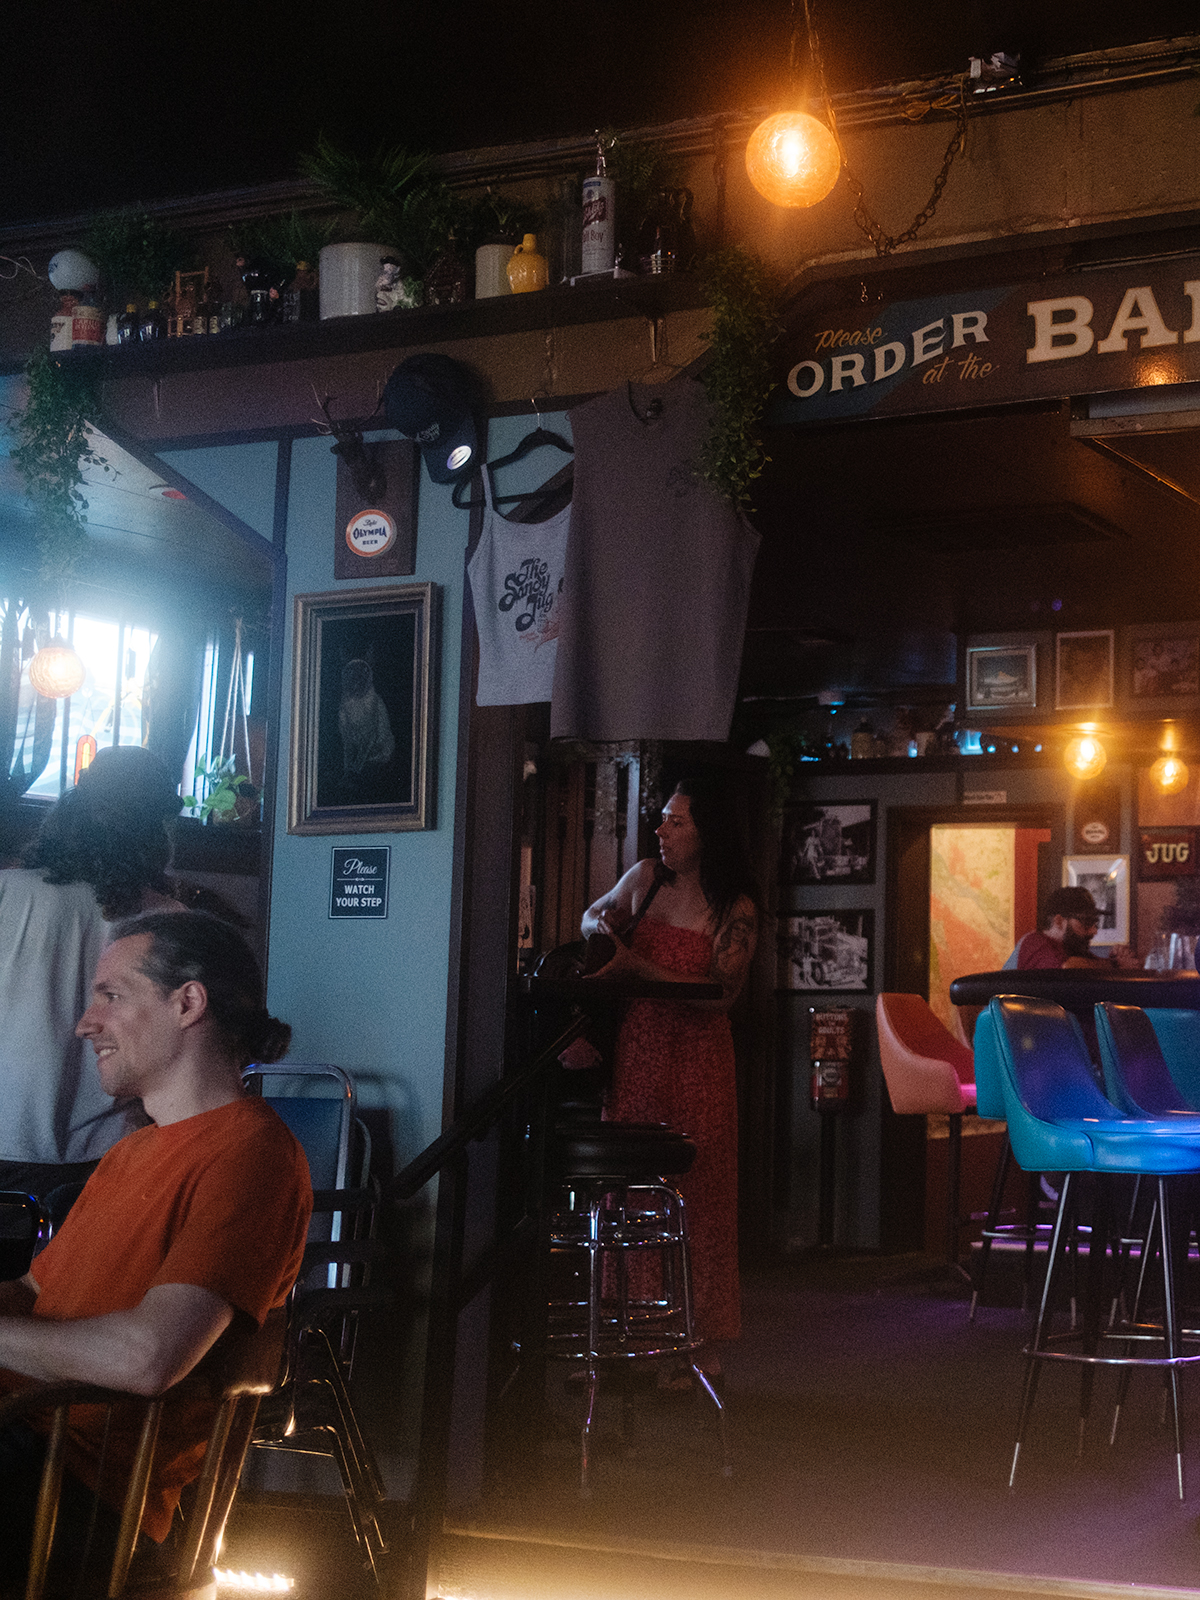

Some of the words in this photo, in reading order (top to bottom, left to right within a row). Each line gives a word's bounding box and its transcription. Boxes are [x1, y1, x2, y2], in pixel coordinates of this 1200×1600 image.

[787, 310, 990, 398] ORDER
[922, 356, 956, 385] at
[958, 352, 1000, 380] the
[353, 526, 388, 540] OLYMPIA
[517, 557, 548, 584] The
[498, 573, 551, 612] Sandy
[515, 591, 554, 632] Jug
[1145, 842, 1189, 864] JUG
[342, 858, 378, 875] Please
[335, 896, 359, 907] YOUR
[360, 896, 382, 907] STEP
[344, 884, 375, 895] WATCH
